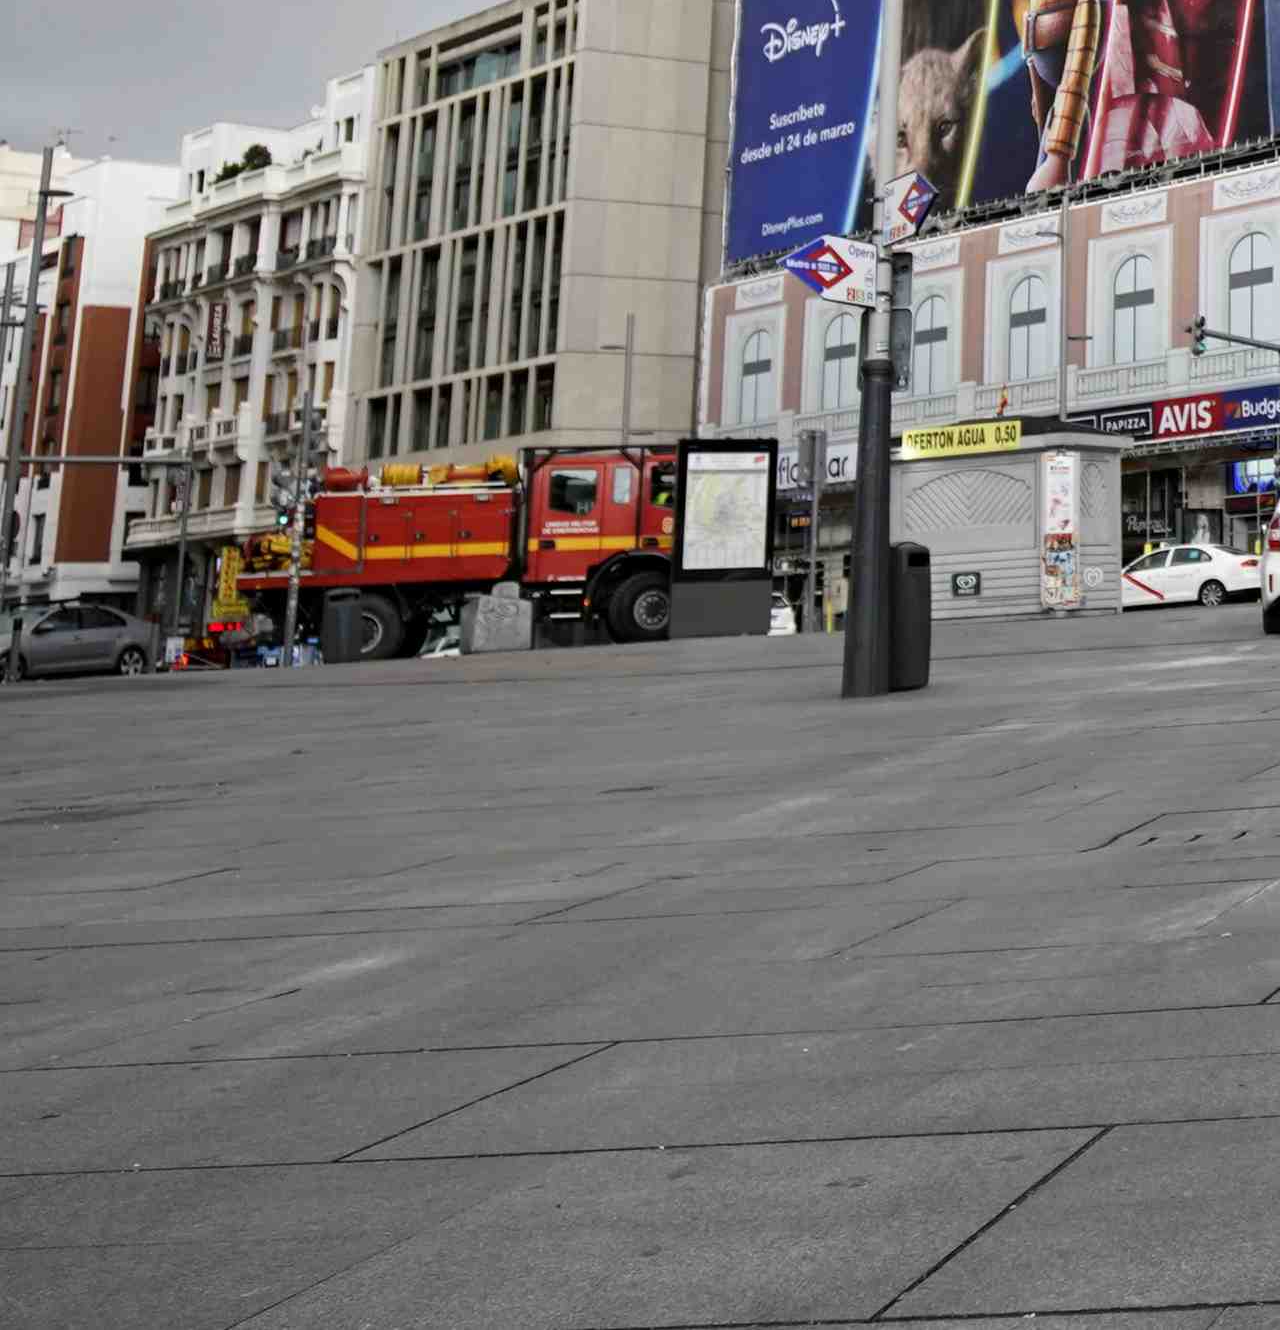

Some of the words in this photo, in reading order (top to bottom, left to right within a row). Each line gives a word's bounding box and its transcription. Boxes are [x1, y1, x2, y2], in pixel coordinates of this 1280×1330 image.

[761, 18, 846, 63] Disney+
[740, 142, 772, 164] desde
[774, 137, 784, 155] el
[786, 134, 801, 151] 24
[803, 129, 817, 146] de
[820, 121, 855, 142] marzo
[1106, 418, 1147, 433] PAPIZZA
[1158, 400, 1213, 434] AVIS
[957, 427, 985, 446] AGUA
